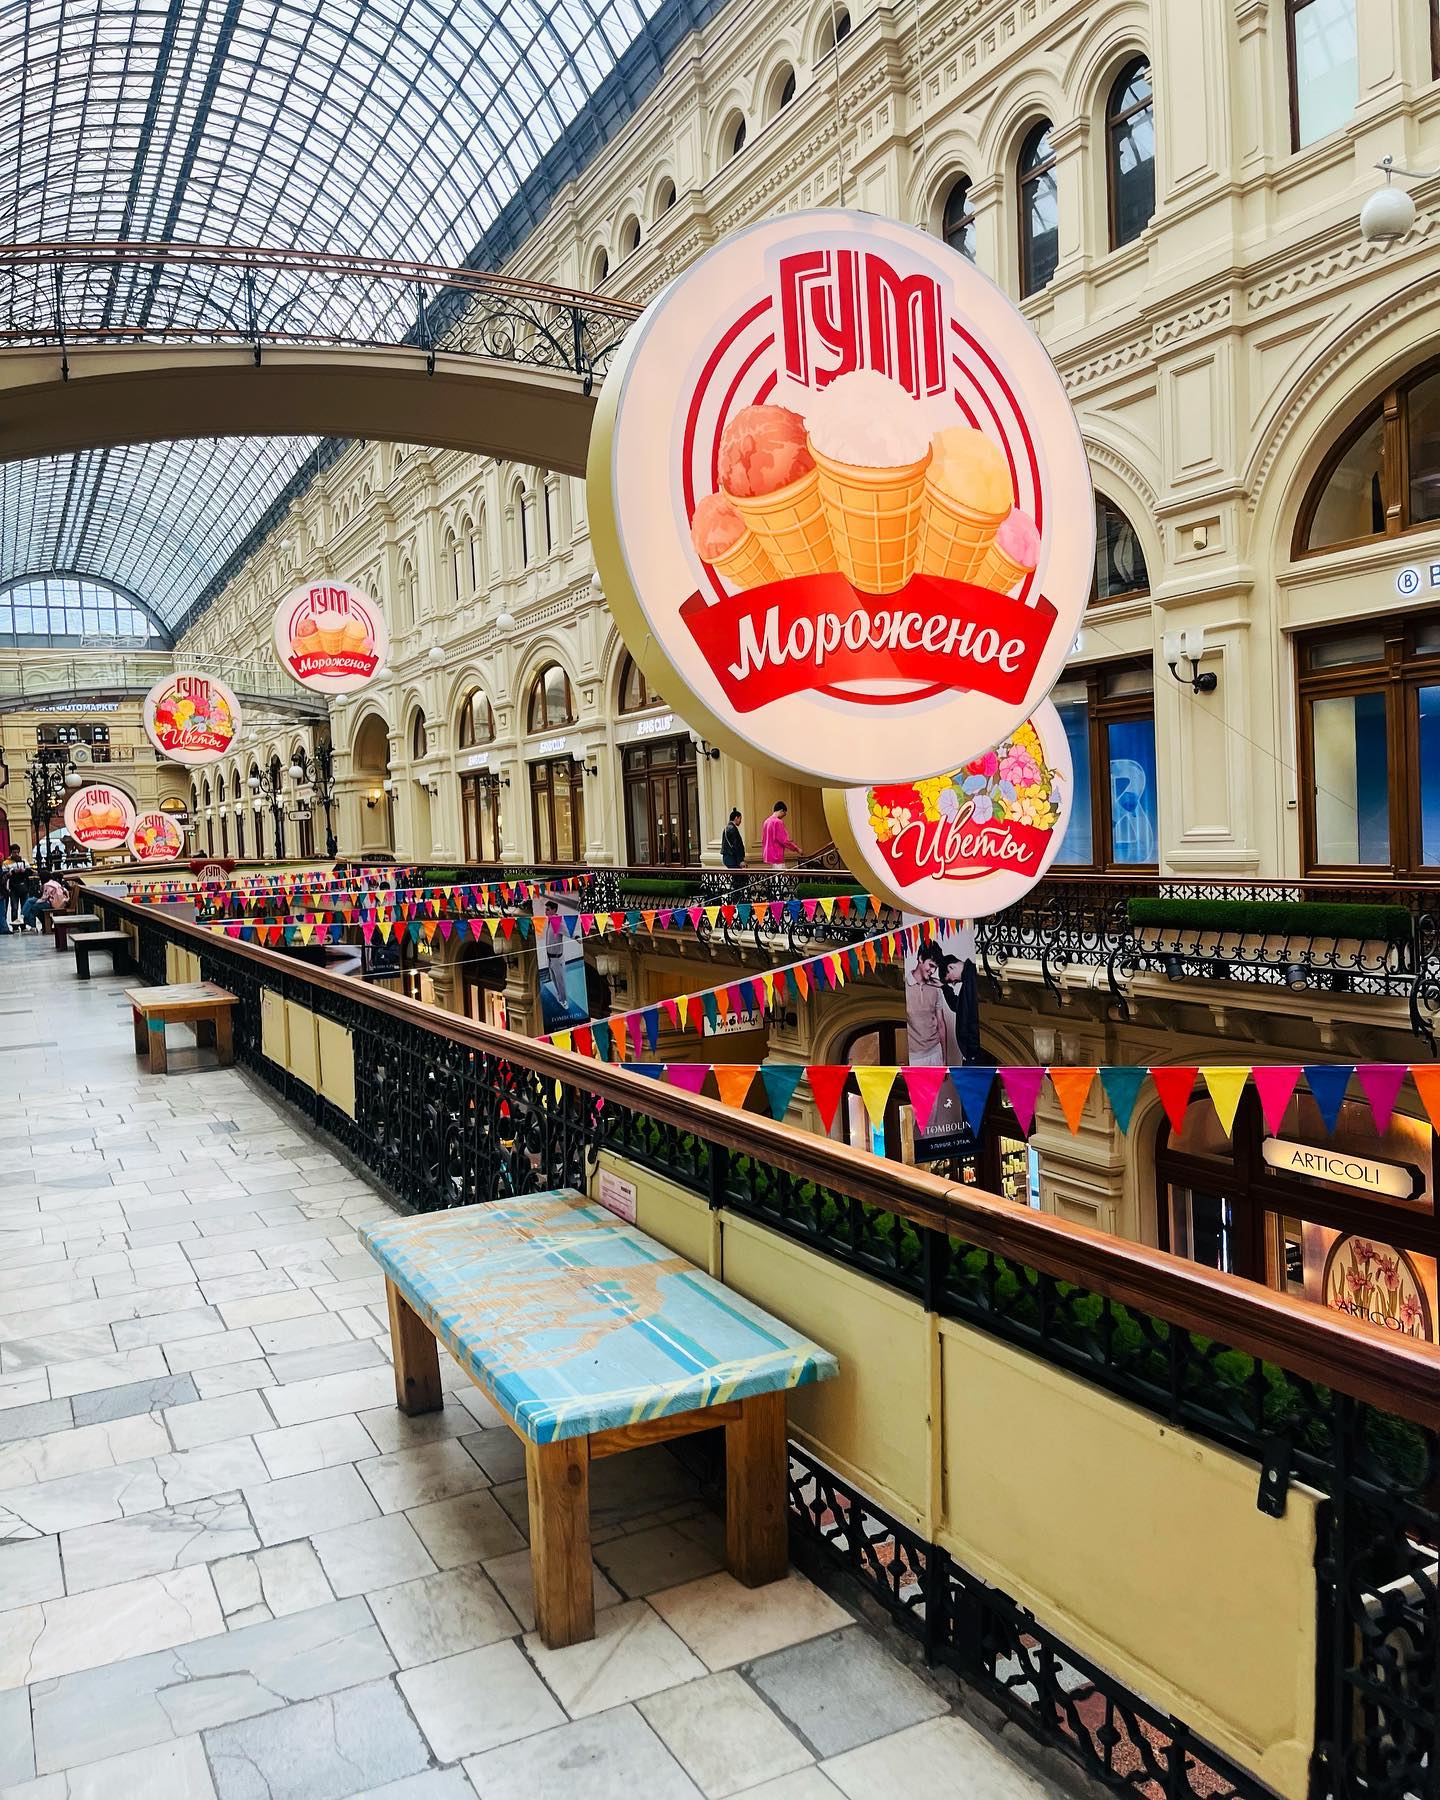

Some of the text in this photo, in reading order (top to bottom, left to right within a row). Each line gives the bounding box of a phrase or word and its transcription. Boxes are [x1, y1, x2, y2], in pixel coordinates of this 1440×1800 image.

[780, 249, 946, 401] ГУМ
[309, 587, 350, 616] ГУМ
[727, 605, 1026, 681] Мороженое
[299, 657, 372, 674] Мороженое
[176, 676, 210, 698] ГУМ
[163, 724, 224, 749] Цветы
[86, 790, 111, 806] ГУМ
[80, 829, 126, 841] Мороженое
[891, 801, 1034, 880] Цветы
[926, 1121, 971, 1135] TOMBOLIN
[1291, 1150, 1379, 1184] ARTICOLI
[1338, 1301, 1415, 1337] ARTICOLI
